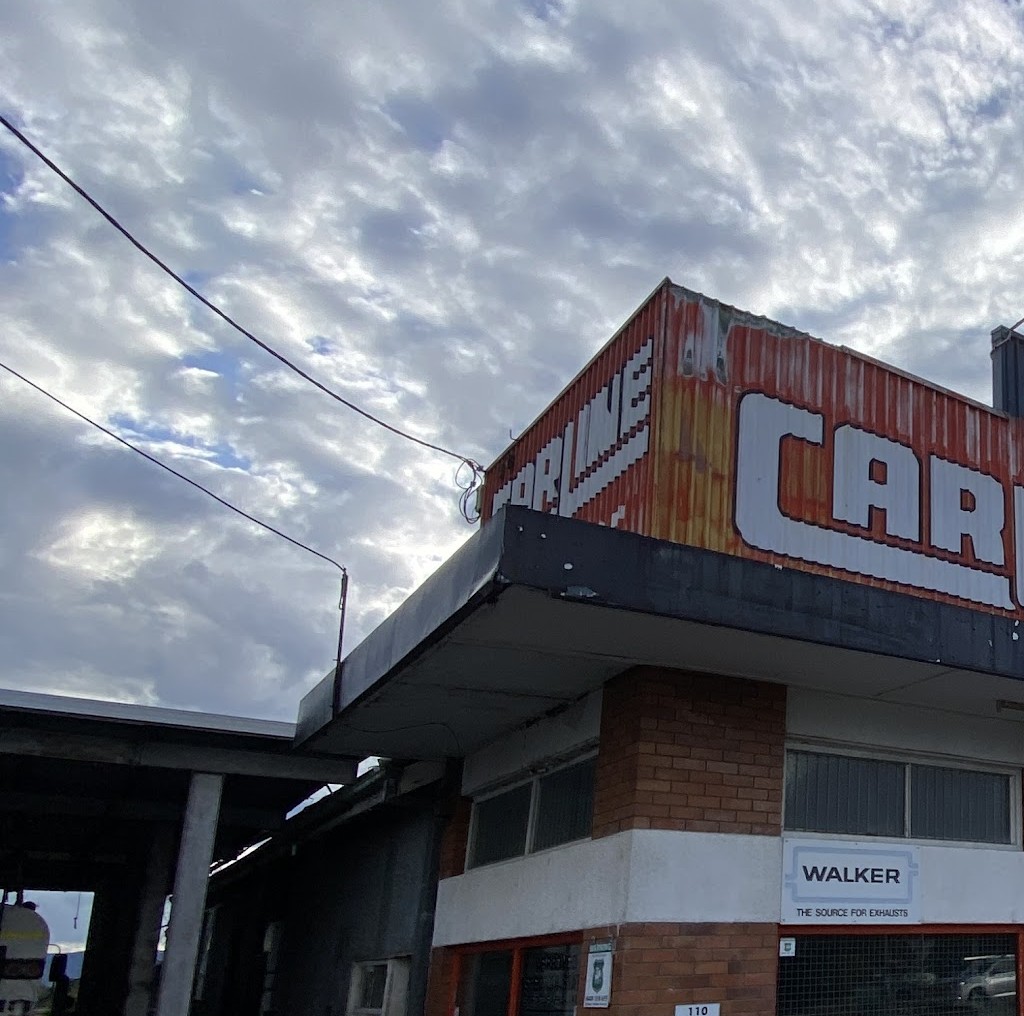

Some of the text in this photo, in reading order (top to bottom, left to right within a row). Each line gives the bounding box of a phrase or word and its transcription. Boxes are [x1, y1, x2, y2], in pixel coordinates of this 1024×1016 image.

[802, 865, 901, 884] WALKER
[797, 908, 908, 918] THE SOURCE FOR EXHAUSTS
[688, 1006, 708, 1016] 110
